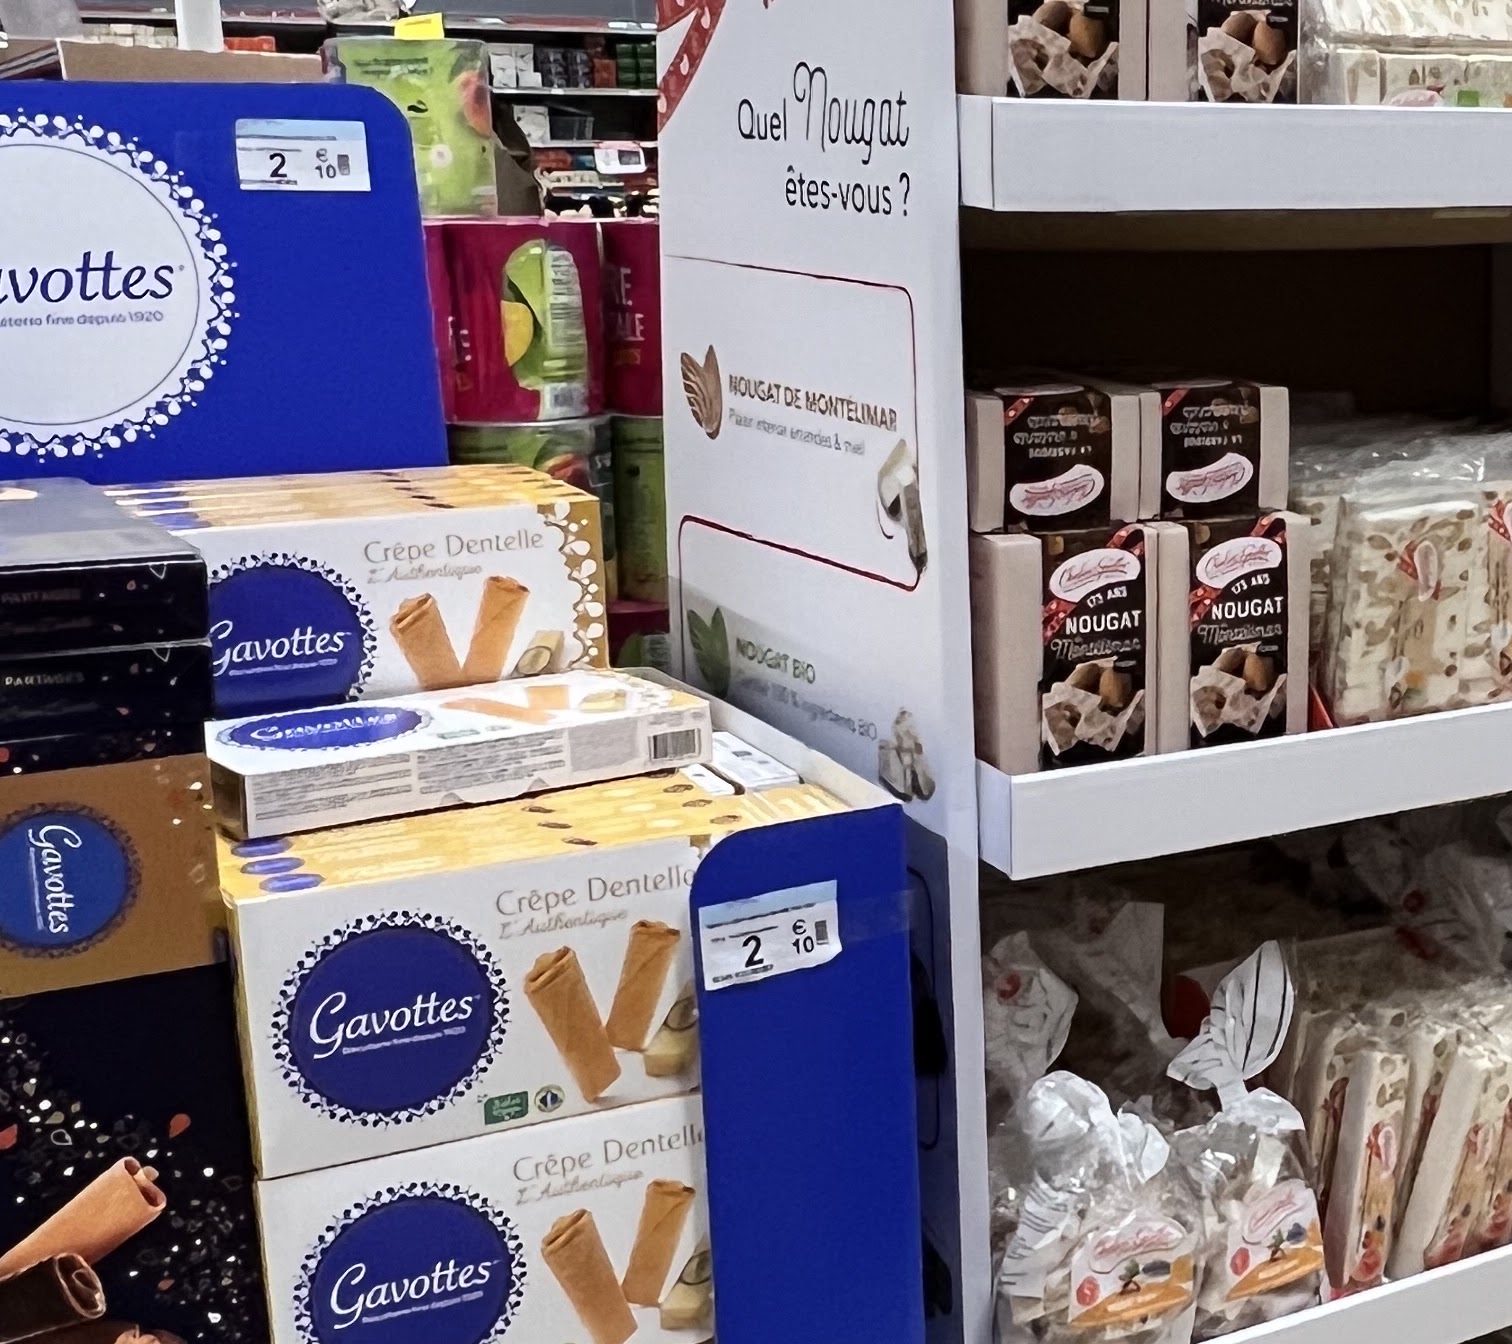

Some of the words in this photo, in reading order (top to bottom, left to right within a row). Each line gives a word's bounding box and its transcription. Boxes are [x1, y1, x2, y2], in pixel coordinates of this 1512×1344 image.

[737, 98, 787, 142] Quel
[793, 61, 911, 166] Nougat
[269, 153, 288, 179] 2
[315, 164, 337, 180] 10
[784, 166, 892, 216] êtes-vous
[898, 172, 911, 217] ?
[0, 250, 174, 307] vottes
[729, 373, 782, 404] NOUGAT
[784, 386, 802, 410] DE
[364, 539, 438, 567] Crêpe
[446, 529, 544, 557] Dentelle
[1065, 609, 1142, 635] NOUGAT
[1211, 596, 1284, 621] NOUGAT
[210, 620, 346, 677] Gavottes
[29, 824, 82, 935] Gavottes
[496, 888, 576, 917] Crêpe
[742, 934, 764, 968] 2
[791, 935, 814, 955] 10
[310, 991, 473, 1060] Gavottes
[513, 1152, 593, 1183] Crêpe
[604, 1124, 703, 1165] Dentell
[331, 1260, 491, 1330] Gavottes
